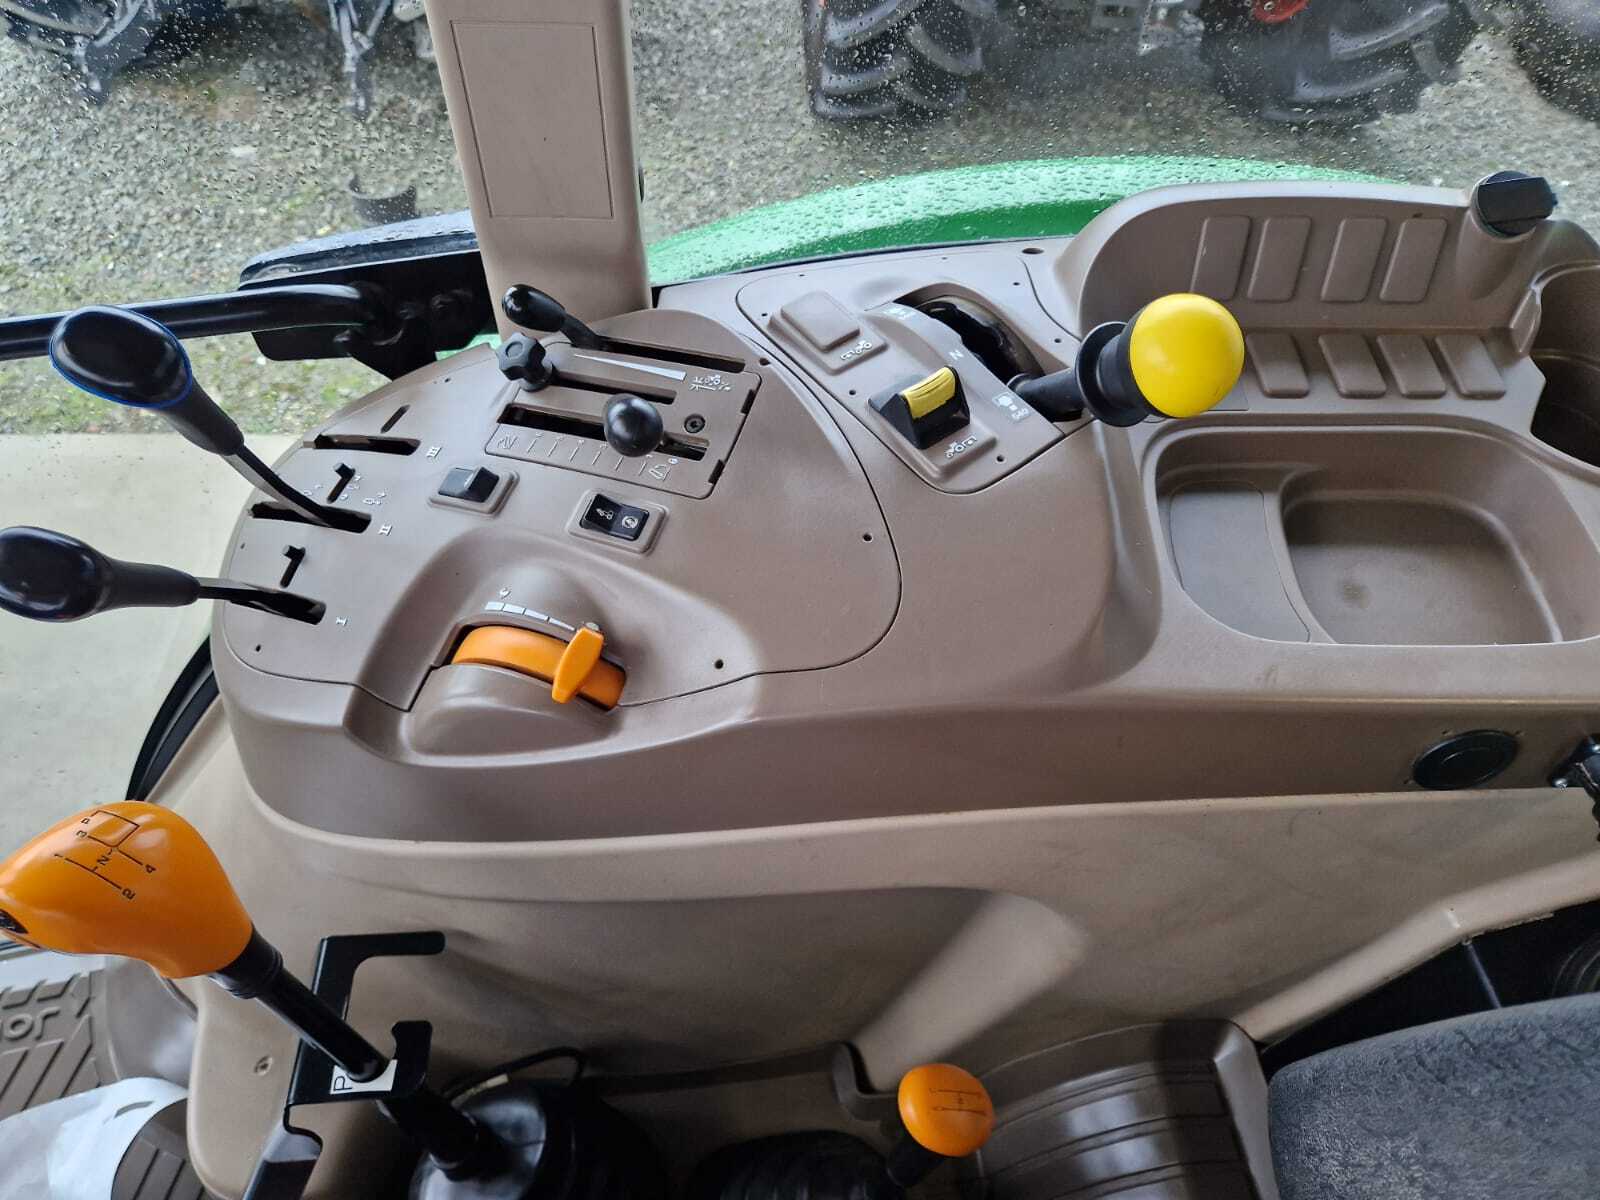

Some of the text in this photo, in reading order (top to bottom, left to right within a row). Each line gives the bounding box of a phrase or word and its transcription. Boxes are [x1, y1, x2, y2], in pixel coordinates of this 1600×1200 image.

[76, 829, 87, 838] 3
[97, 854, 110, 866] N
[145, 863, 156, 874] 4
[121, 887, 136, 900] 2
[333, 1074, 353, 1092] P
